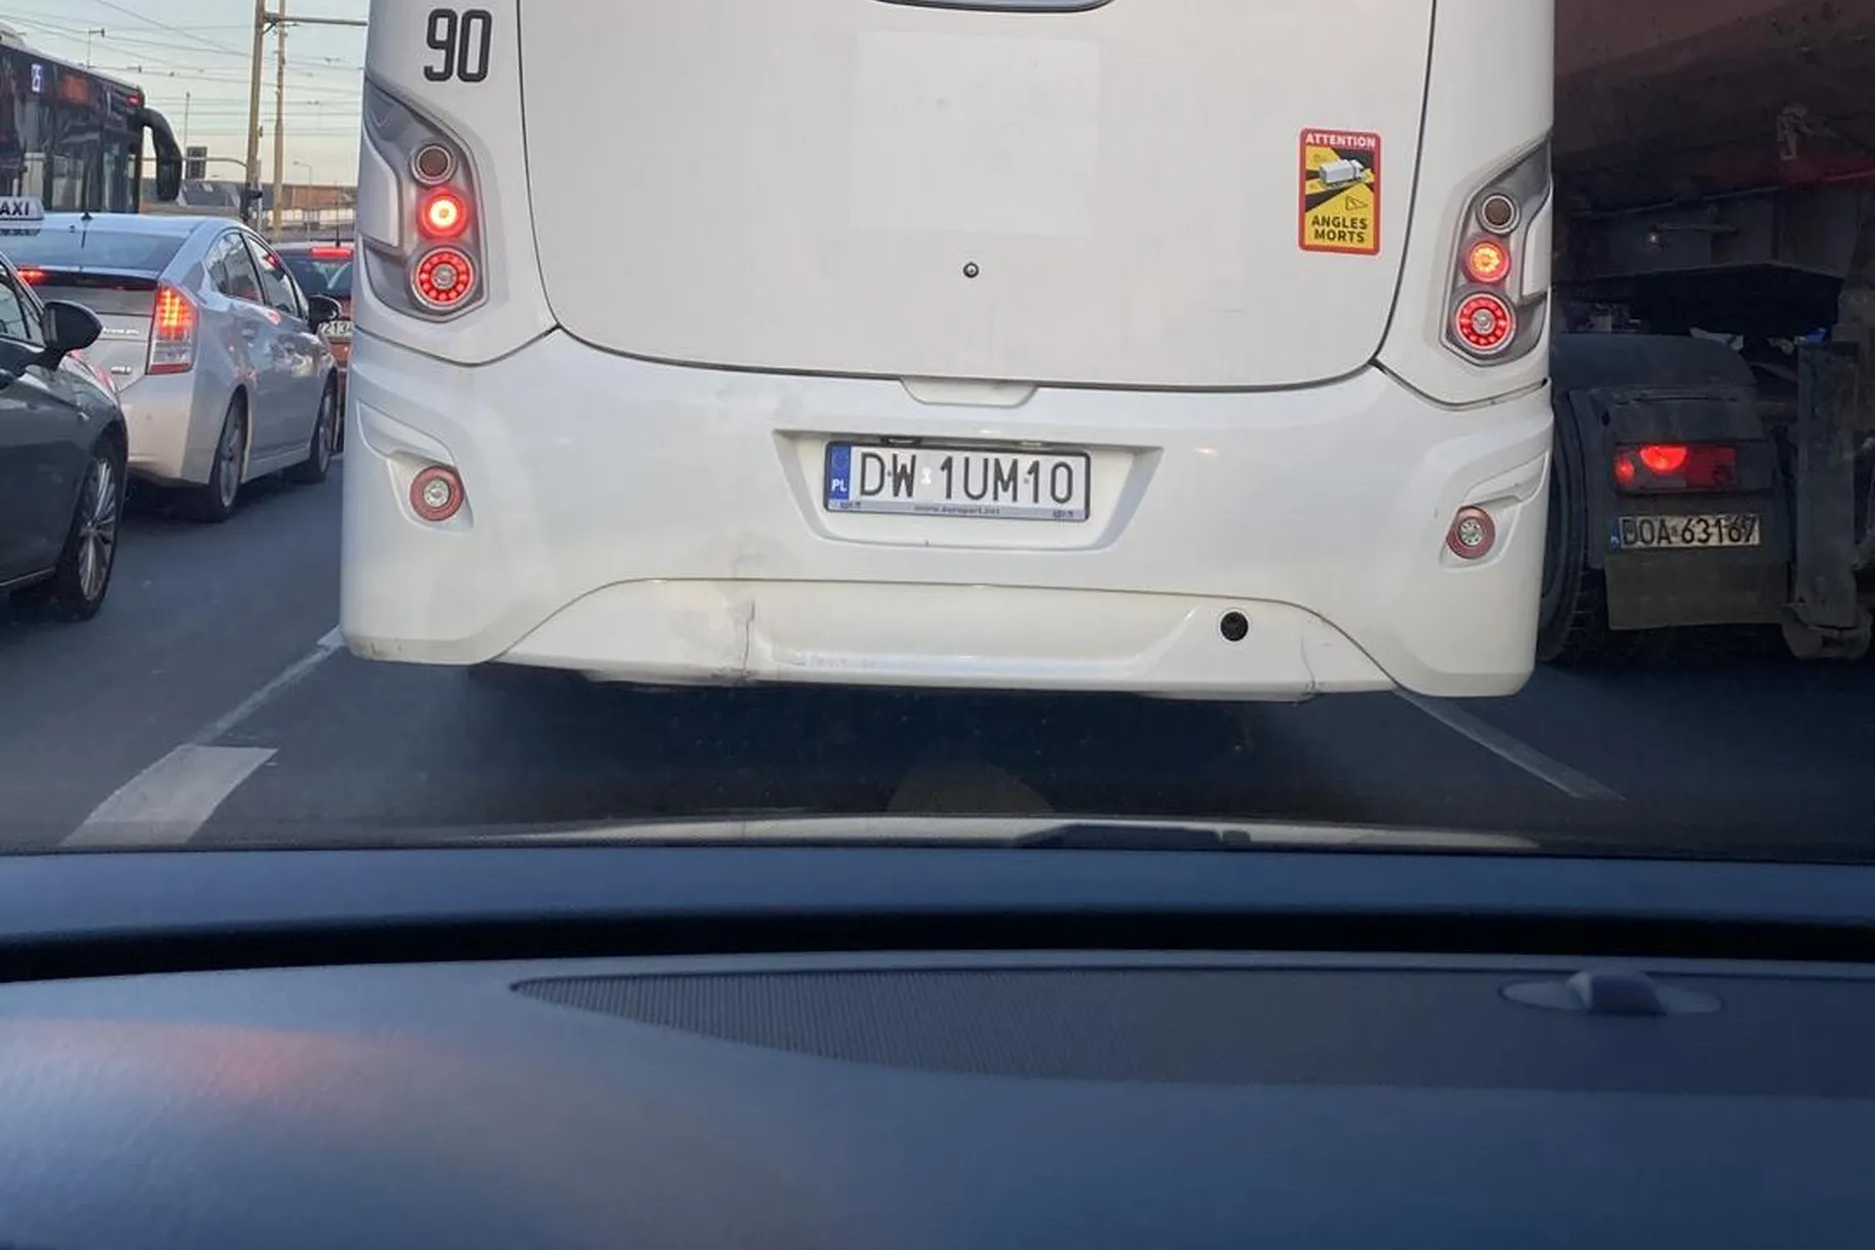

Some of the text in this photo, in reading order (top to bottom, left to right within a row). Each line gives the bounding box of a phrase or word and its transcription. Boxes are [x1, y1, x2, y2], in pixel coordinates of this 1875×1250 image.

[423, 8, 492, 83] 90
[1305, 133, 1376, 148] ATTENTION
[0, 201, 29, 216] AXI
[1311, 215, 1368, 230] ANGLES
[1313, 229, 1365, 243] MORTS
[831, 479, 848, 492] PL
[860, 452, 1074, 505] DW 1UM10
